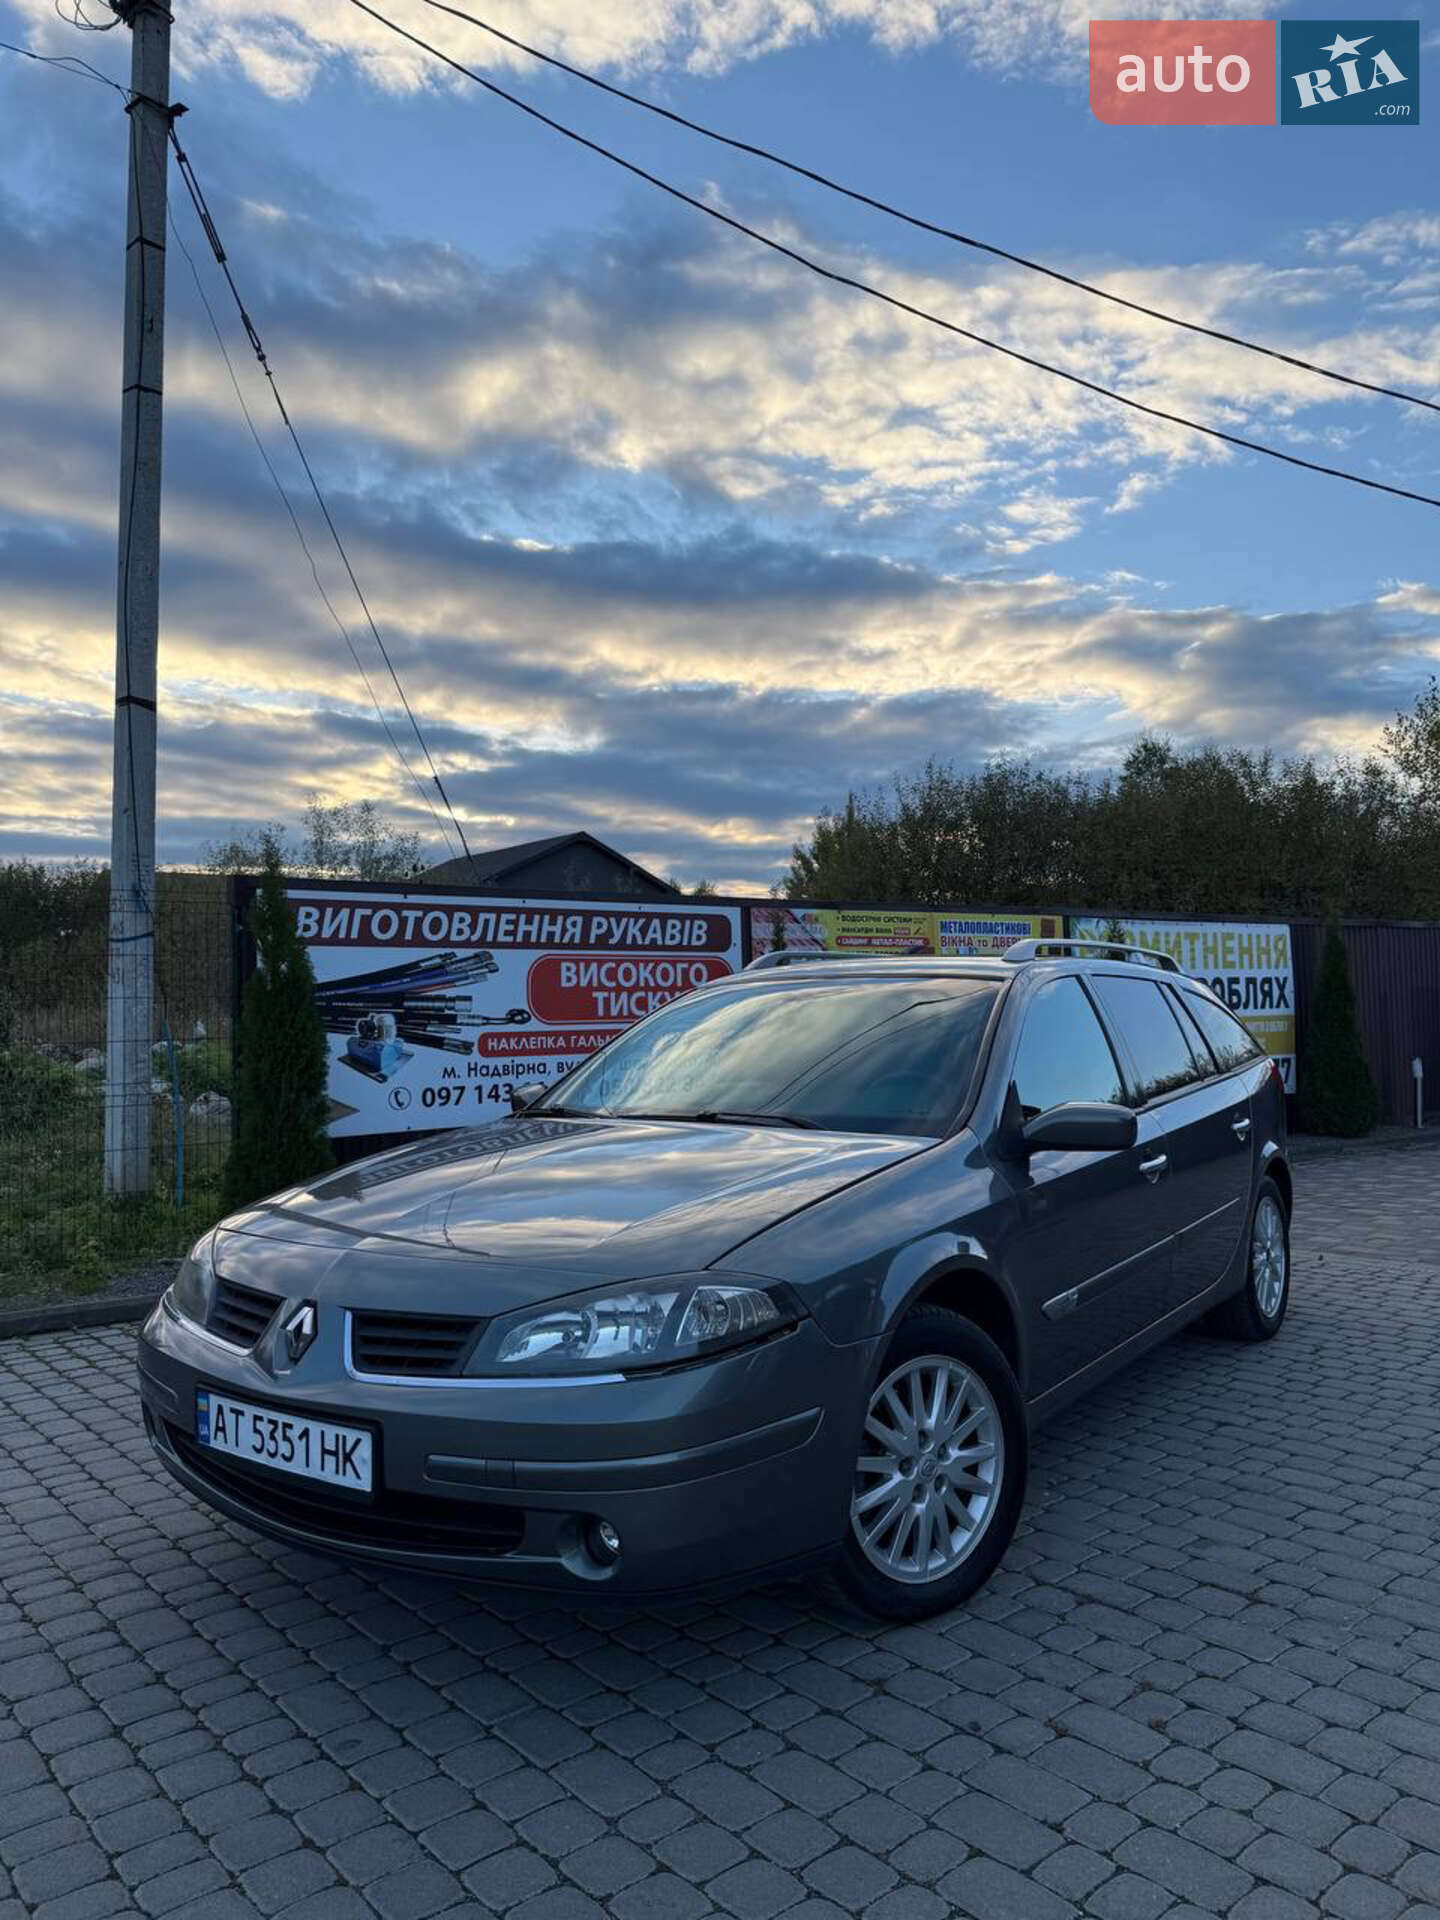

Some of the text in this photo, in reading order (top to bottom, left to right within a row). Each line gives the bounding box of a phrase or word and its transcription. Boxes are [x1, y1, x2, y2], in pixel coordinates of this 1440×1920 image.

[296, 906, 708, 946] ВИГОТОВЛЕННЯ РУКАВІВ
[940, 920, 1032, 936] МЕТАЛОПЛАСТИКОВІ
[940, 935, 974, 948] ВІКНА
[992, 936, 1021, 950] ДВЕР
[560, 961, 709, 988] ВИСОКОГО
[488, 1036, 566, 1051] НАКЛЕПКА
[442, 1066, 461, 1079] м.
[467, 1060, 551, 1079] Надвірна,
[421, 1083, 514, 1108] 097 143
[213, 1404, 362, 1480] AT 5351 HK
